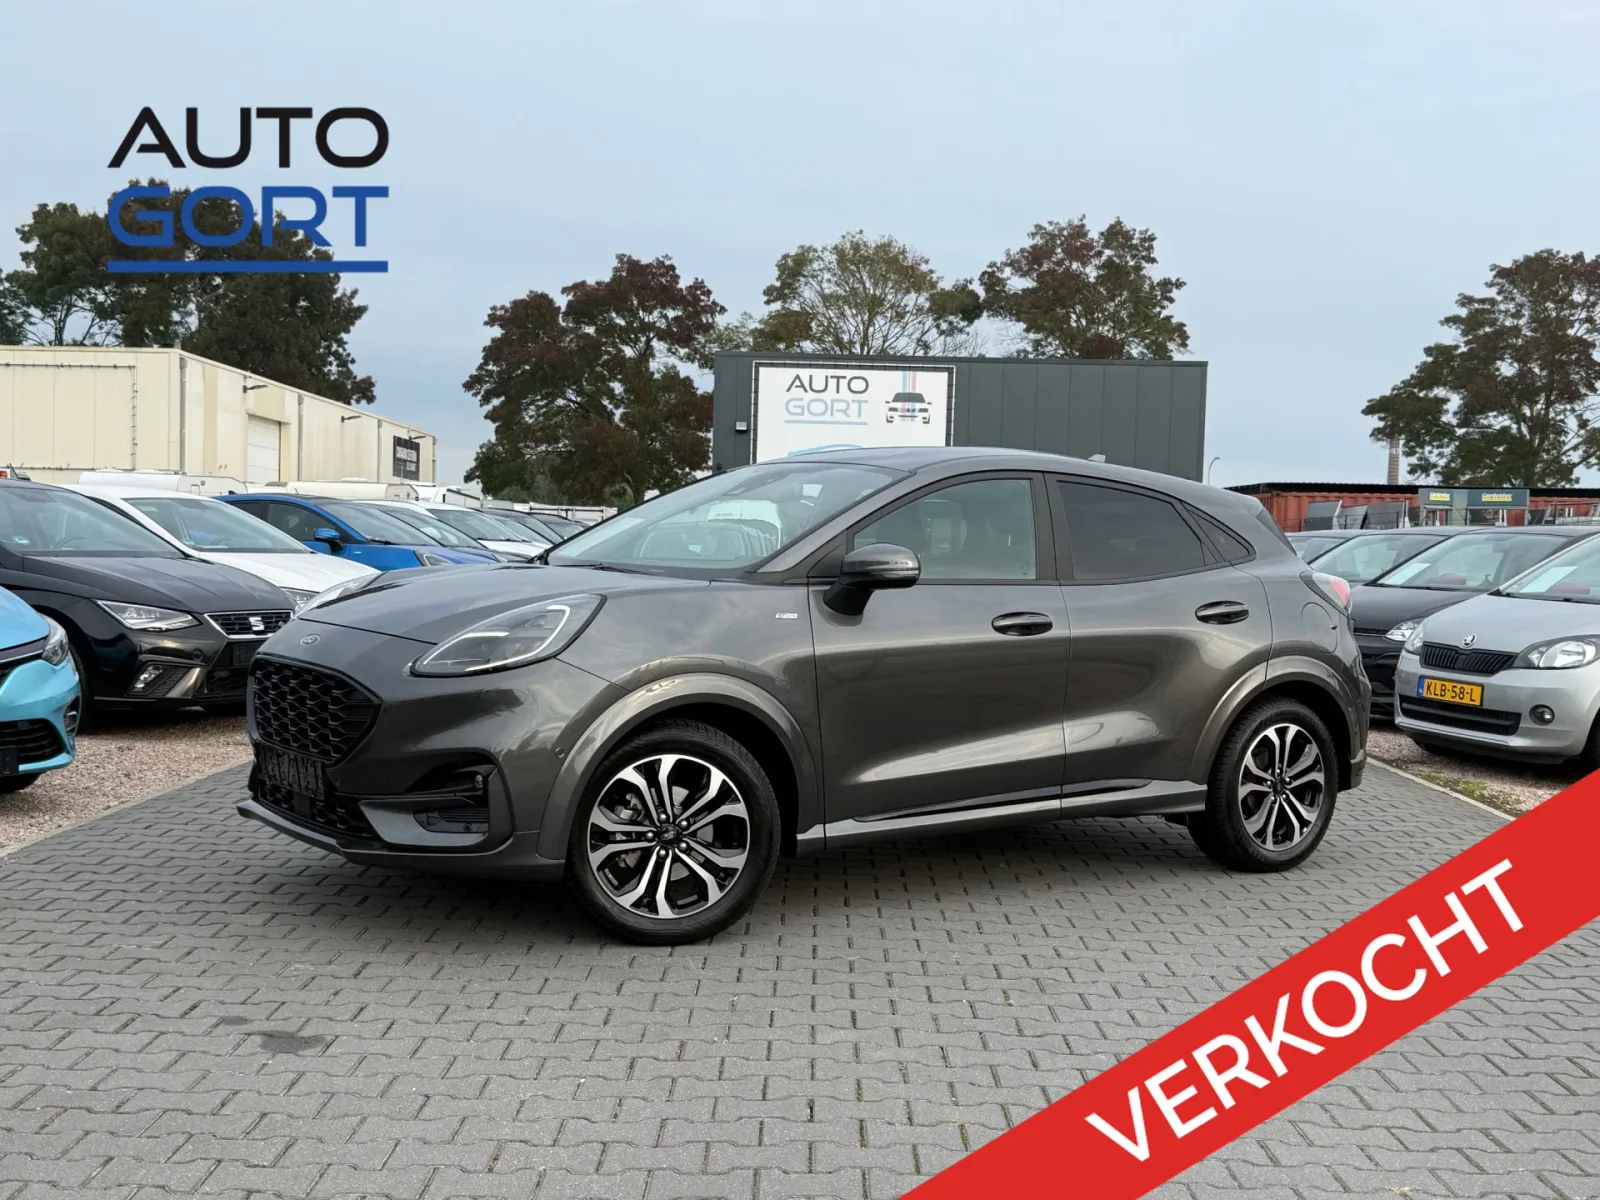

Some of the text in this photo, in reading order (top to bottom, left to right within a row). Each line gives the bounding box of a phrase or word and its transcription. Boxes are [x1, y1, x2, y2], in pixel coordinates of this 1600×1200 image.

[786, 374, 869, 394] AUTO
[785, 397, 869, 418] GORT
[1426, 681, 1476, 702] KLB-58-L
